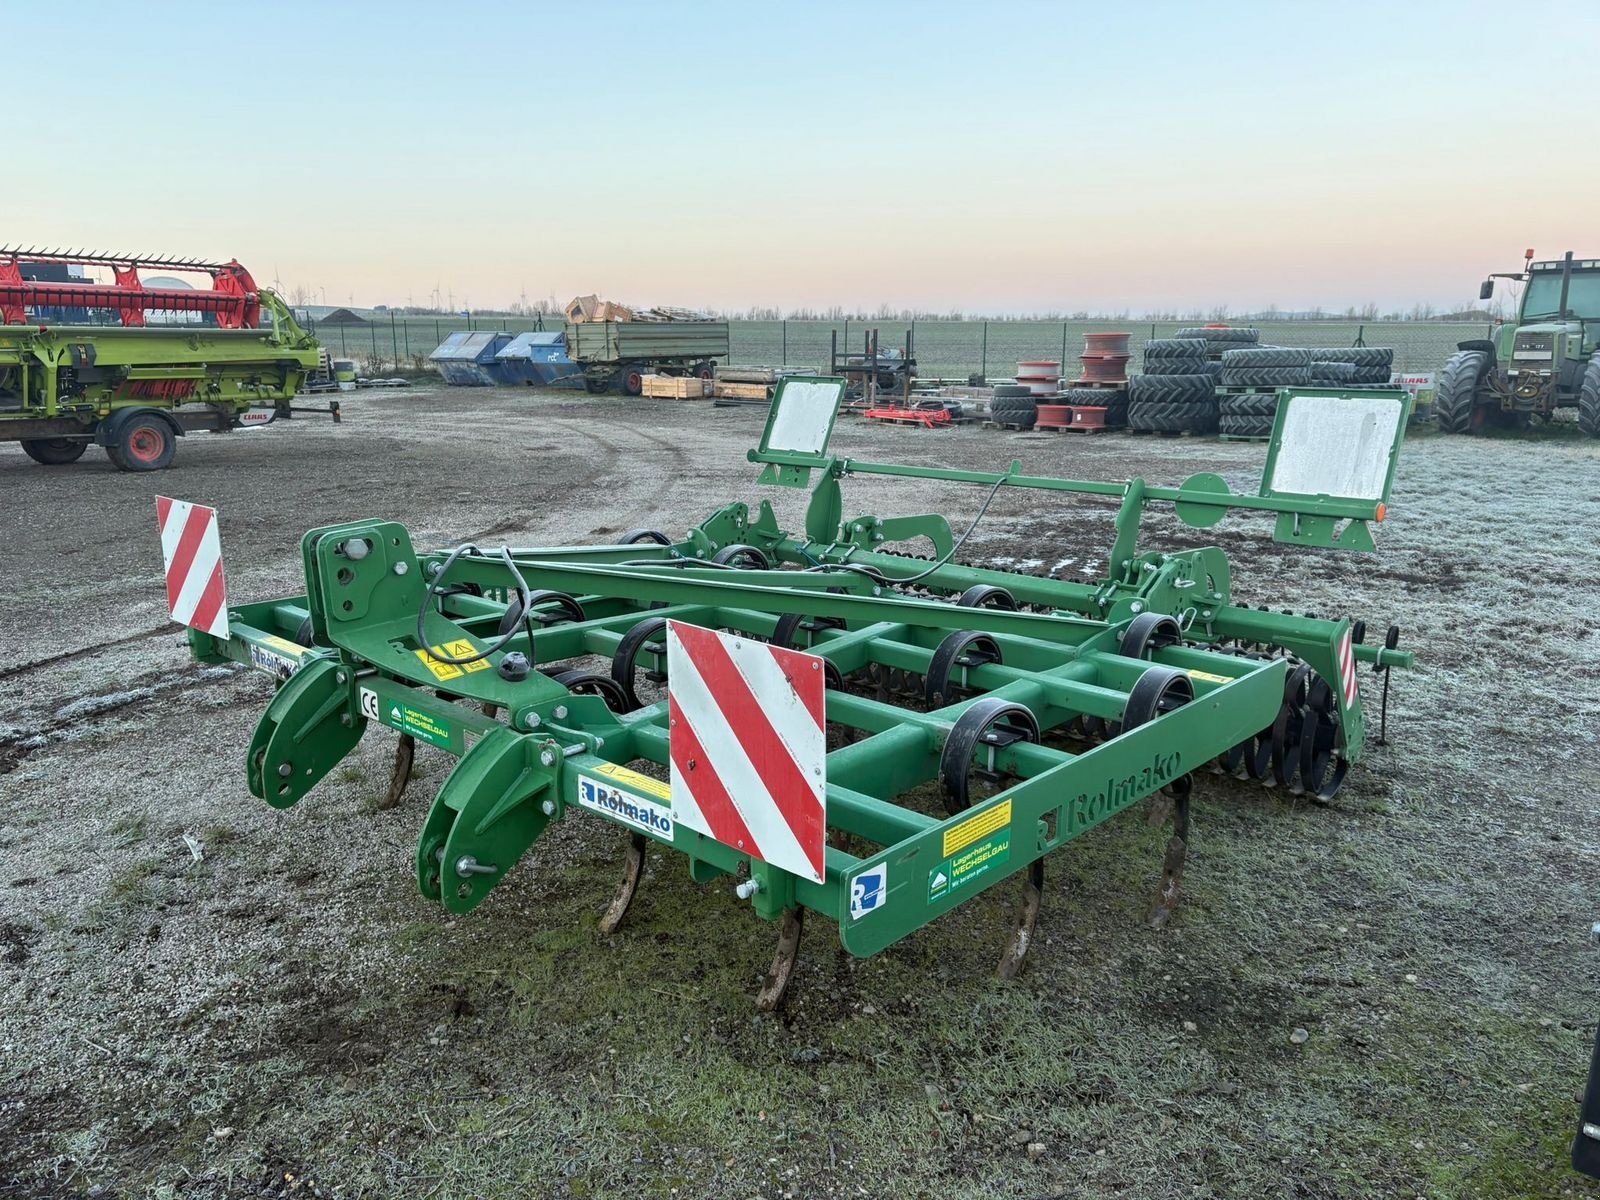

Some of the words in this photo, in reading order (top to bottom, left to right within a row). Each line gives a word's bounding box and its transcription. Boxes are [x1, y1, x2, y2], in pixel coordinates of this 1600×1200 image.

[362, 692, 377, 717] CE
[597, 787, 671, 832] Rolmako
[1067, 752, 1182, 836] Rolmako
[952, 840, 1009, 878] WECHSELGAU
[953, 842, 992, 867] Lagerhaus
